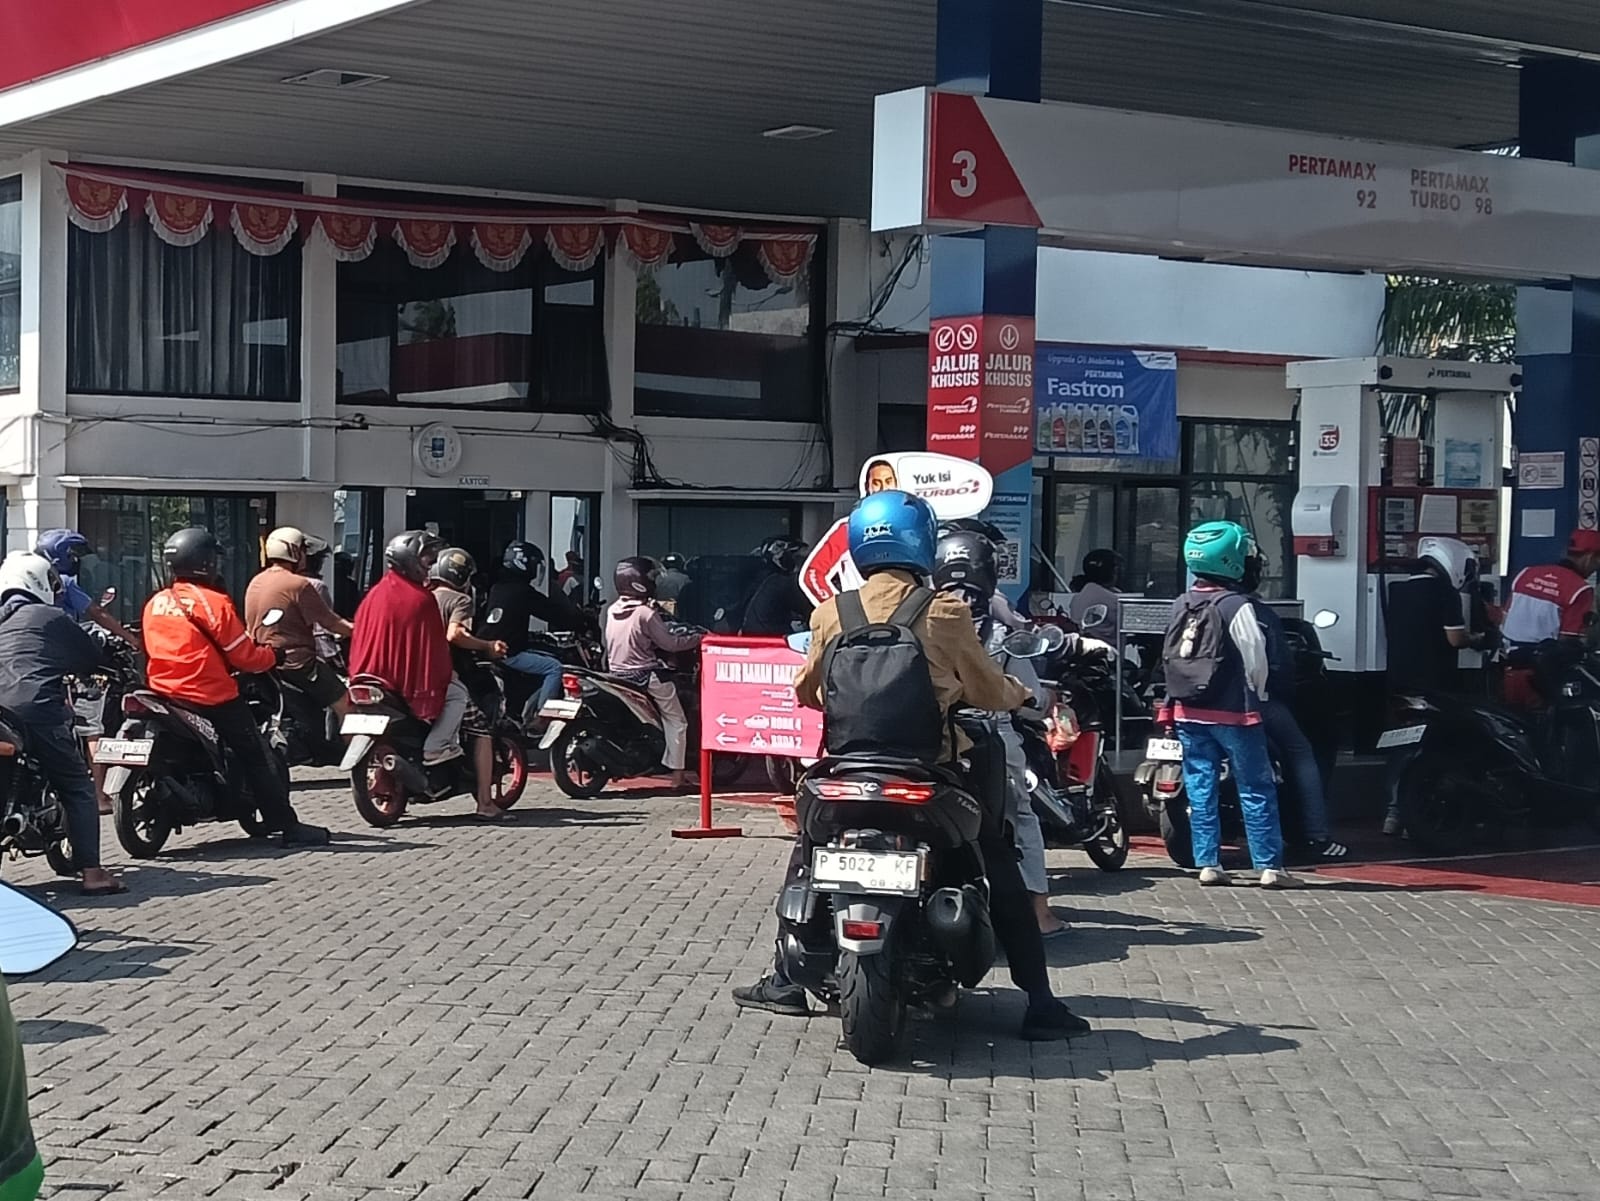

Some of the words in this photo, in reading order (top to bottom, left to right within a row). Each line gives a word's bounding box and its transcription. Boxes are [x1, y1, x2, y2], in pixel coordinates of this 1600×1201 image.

[950, 149, 978, 199] 3
[1288, 153, 1377, 182] PERTAMAX
[1410, 168, 1490, 195] PERTAMAX
[1356, 188, 1377, 210] 92
[1410, 188, 1461, 212] TURBO
[1474, 195, 1493, 216] 98
[931, 353, 980, 373] JALUR
[985, 353, 1032, 372] JALUR
[931, 373, 980, 388] KHUSUS
[985, 372, 1032, 387] KHUSUS
[1047, 378, 1125, 399] Fastron
[913, 472, 937, 485] Yuk
[938, 470, 952, 483] Isi
[914, 487, 969, 499] TURBO
[794, 718, 802, 732] 4
[795, 736, 803, 750] 2
[819, 854, 829, 870] P
[838, 856, 876, 873] 5022
[894, 859, 915, 875] KF
